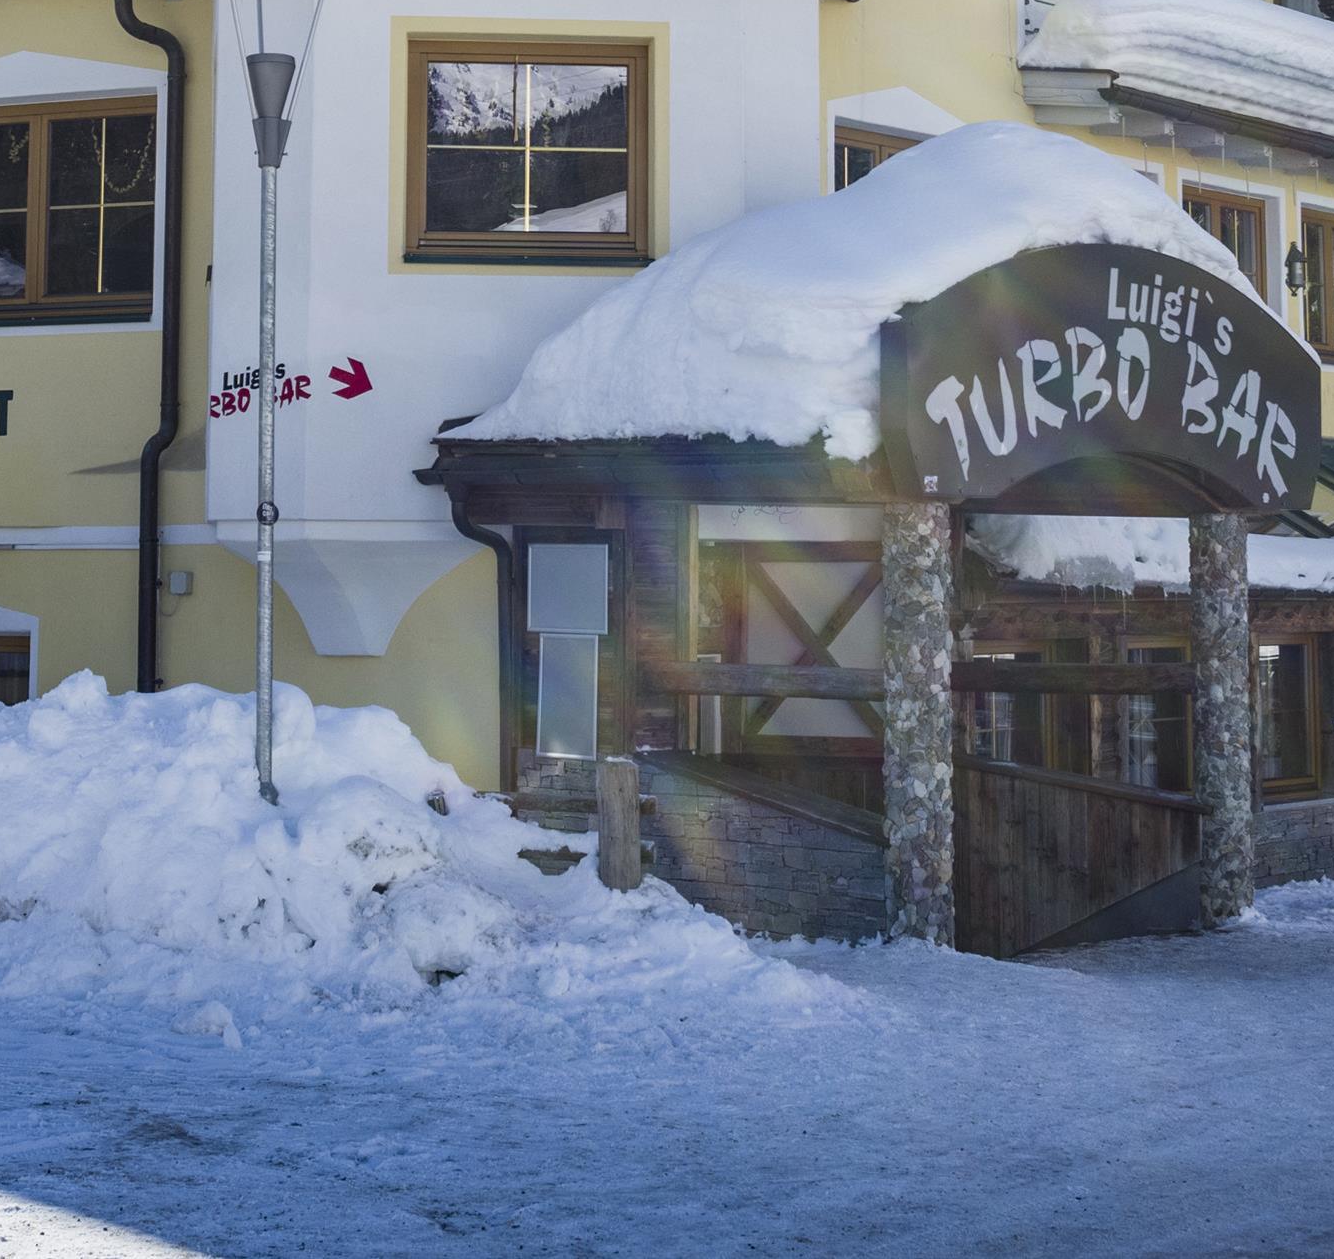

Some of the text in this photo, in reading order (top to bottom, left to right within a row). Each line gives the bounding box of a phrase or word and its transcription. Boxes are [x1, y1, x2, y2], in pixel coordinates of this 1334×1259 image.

[272, 374, 312, 409] AR
[925, 326, 1298, 500] TURBO BAR
